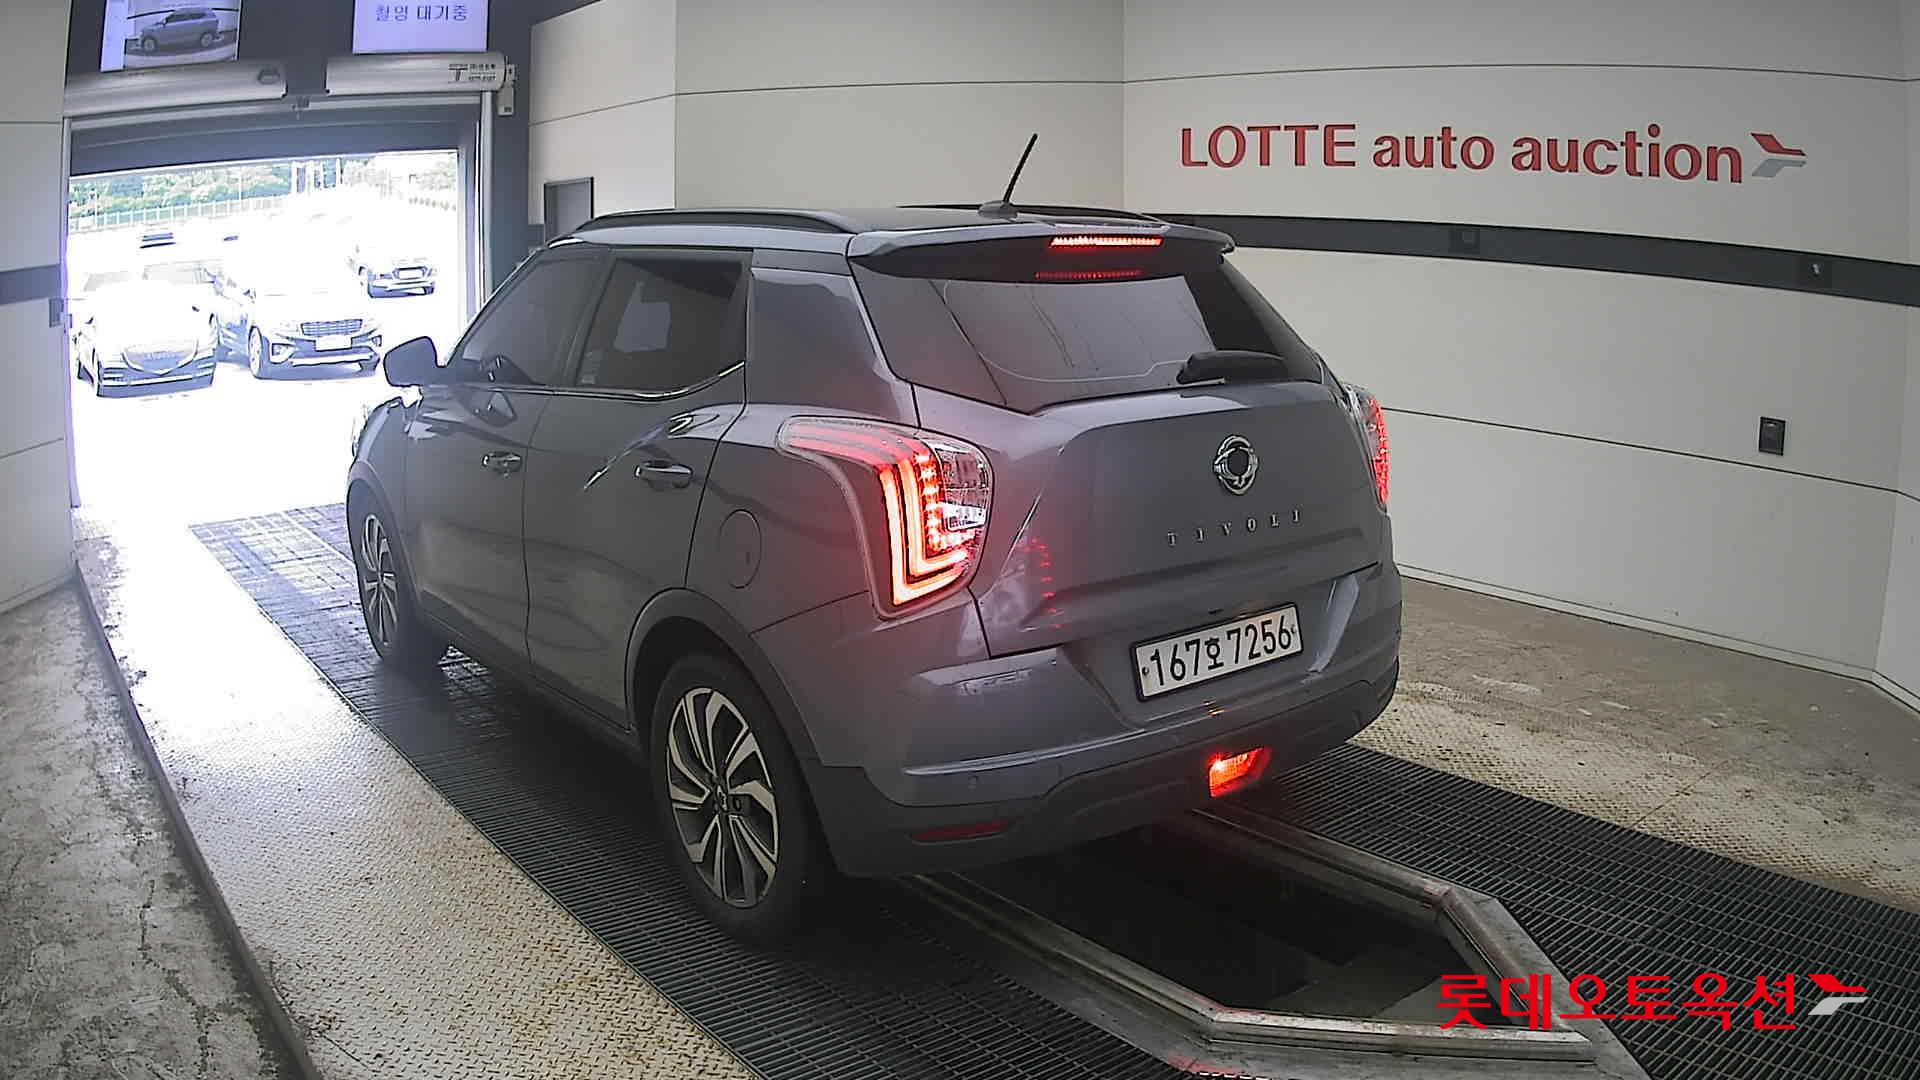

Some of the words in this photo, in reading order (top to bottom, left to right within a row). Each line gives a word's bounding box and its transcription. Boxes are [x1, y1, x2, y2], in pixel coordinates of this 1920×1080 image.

[417, 4, 469, 22] 대기중
[1182, 123, 1357, 168] LOTTE
[1372, 125, 1496, 170] auto
[1511, 123, 1743, 184] auction
[1167, 508, 1302, 546] TIVOLI
